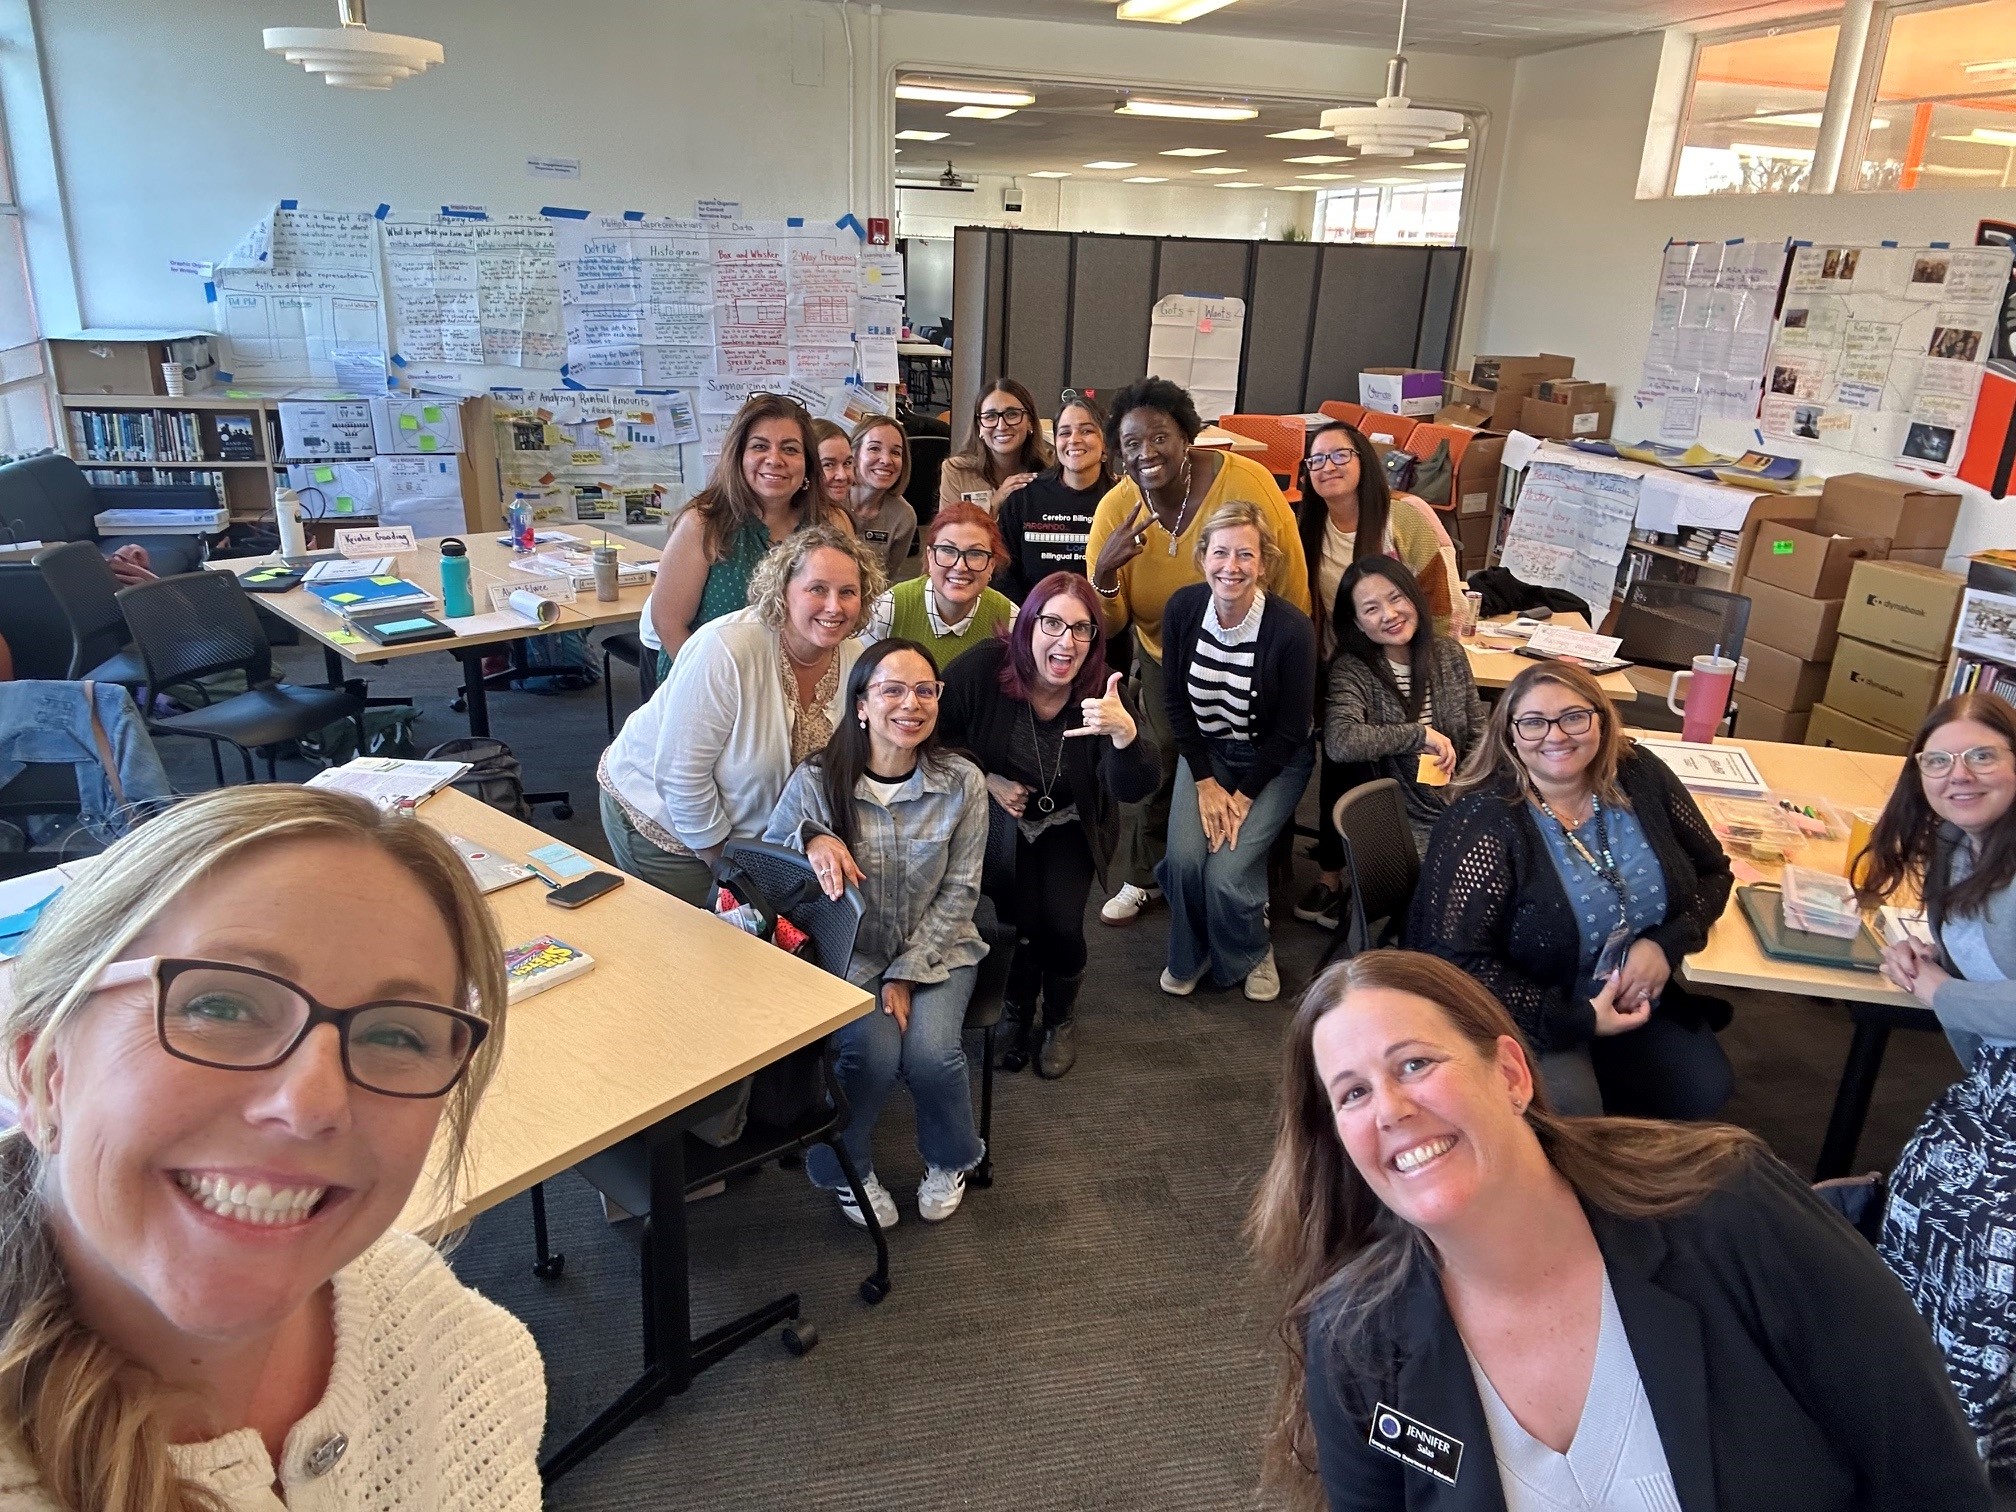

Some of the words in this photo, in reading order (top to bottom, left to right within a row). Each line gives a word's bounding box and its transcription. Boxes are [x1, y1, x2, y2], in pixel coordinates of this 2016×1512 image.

[601, 219, 628, 228] Multiple
[640, 220, 703, 230] Representations
[711, 221, 720, 230] of
[732, 223, 754, 231] Data
[386, 226, 404, 237] What
[476, 228, 491, 238] What
[584, 244, 600, 254] Dot
[601, 243, 617, 254] Plot
[650, 245, 700, 259] Histogram
[717, 249, 732, 260] Box
[736, 249, 748, 259] and
[750, 249, 780, 259] Whisker
[271, 268, 291, 277] Each
[296, 270, 312, 278] data
[318, 271, 369, 280] representation
[255, 282, 274, 290] tells
[285, 281, 314, 290] different
[319, 283, 336, 291] story
[1160, 301, 1184, 316] Gots
[706, 379, 767, 392] Summarizing
[768, 381, 782, 390] and
[506, 393, 524, 407] Story
[527, 392, 537, 402] of
[539, 392, 576, 407] Analyzing
[579, 394, 611, 405] Rainfall
[612, 394, 651, 407] Amounts
[1042, 513, 1072, 522] Cerebro
[1072, 514, 1094, 524] Biling
[374, 531, 411, 546] Gooding
[1041, 552, 1073, 562] Bilingual
[1073, 553, 1087, 561] Bra
[1884, 600, 1927, 617] dynabook
[1866, 679, 1905, 698] dynabook
[1406, 1424, 1452, 1455] JENNIFER
[1416, 1443, 1435, 1459] Salas
